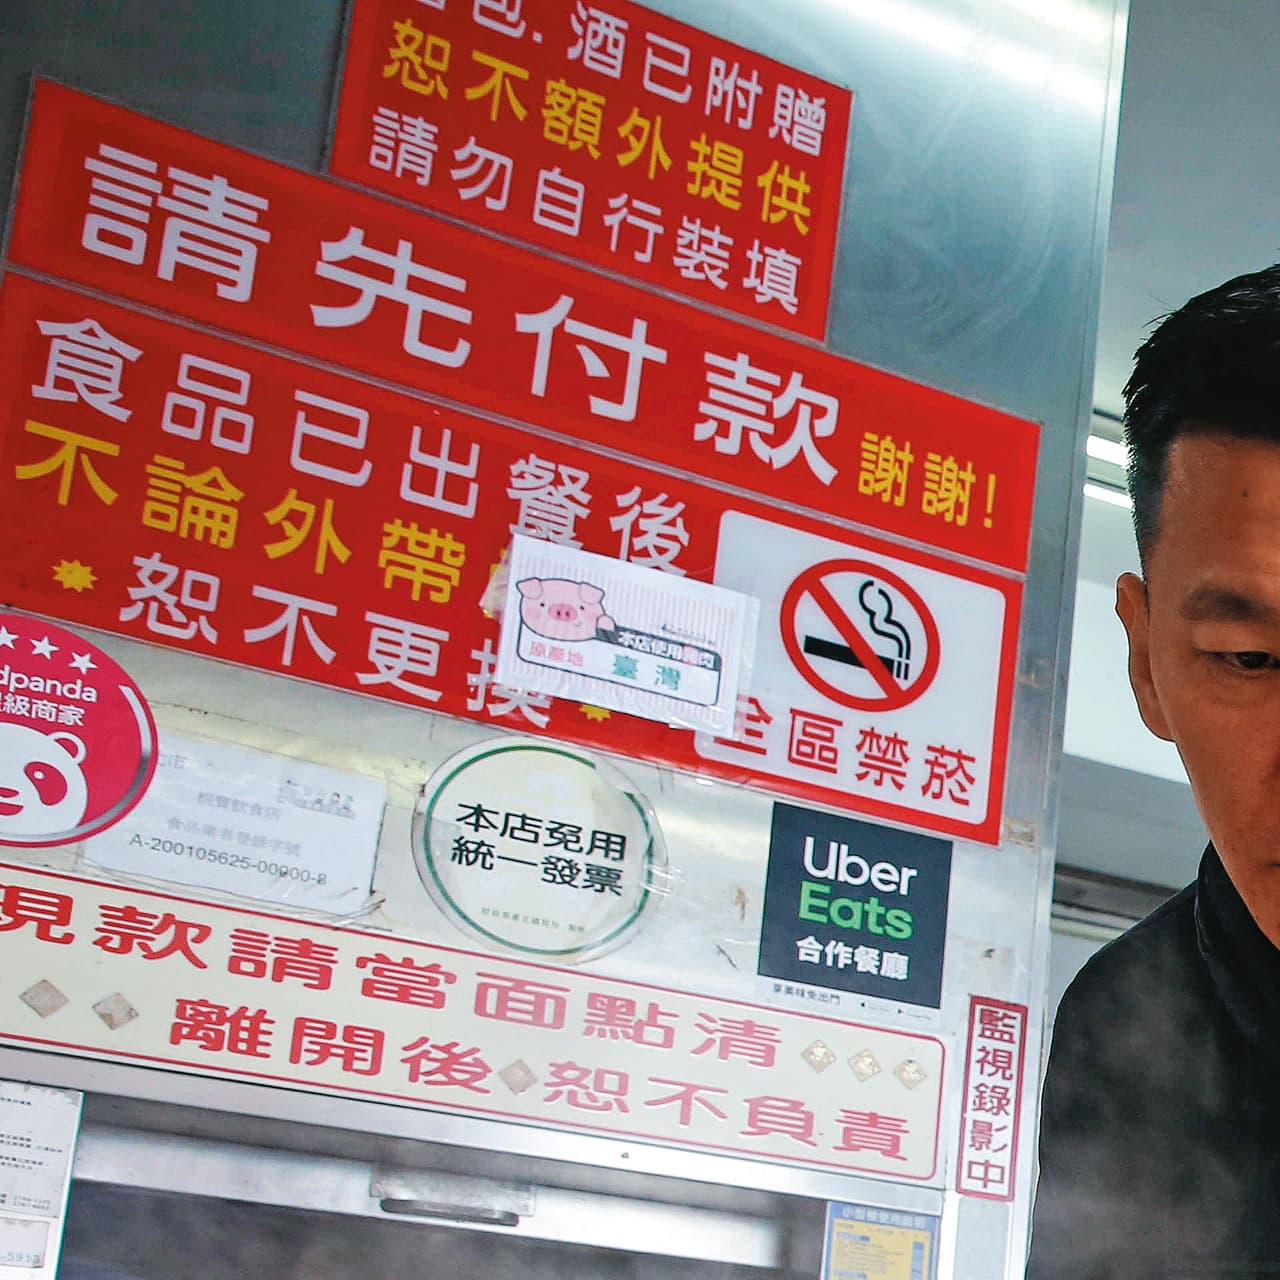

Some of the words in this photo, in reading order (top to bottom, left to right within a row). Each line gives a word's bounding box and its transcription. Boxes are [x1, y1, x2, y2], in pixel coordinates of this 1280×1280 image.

[383, 18, 812, 236] 恕不額外提供
[401, 0, 826, 157] 包.酒已附贈
[368, 106, 802, 315] 請勿自行裝填
[81, 144, 840, 486] 請先付款
[858, 432, 997, 529] 謝謝!
[31, 317, 692, 578] 食品已出餐後
[15, 419, 512, 622] 不論外帶
[0, 692, 86, 727] 級商家
[612, 653, 682, 692] 臺灣
[714, 695, 978, 808] 全區禁菸
[450, 835, 624, 897] 統一發票
[456, 802, 628, 863] 本店免用
[800, 837, 918, 895] Uber
[795, 935, 910, 981] 合作餐廳
[797, 881, 914, 941] Eats
[169, 998, 496, 1095] 離開後
[543, 1061, 914, 1162] 恕不負責
[966, 1006, 1020, 1191] 監視錄影中
